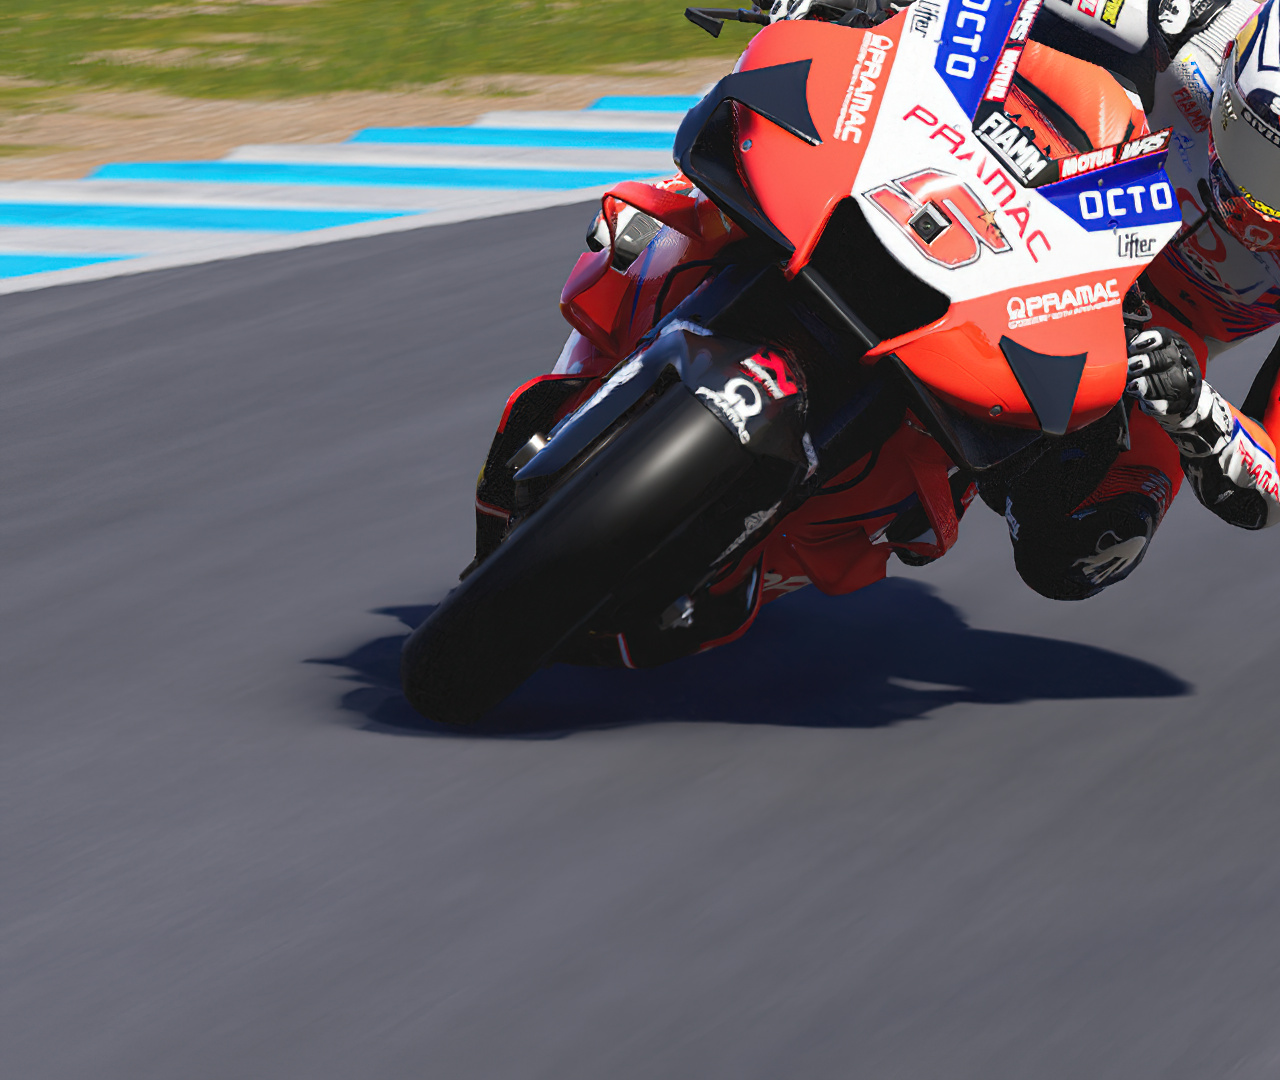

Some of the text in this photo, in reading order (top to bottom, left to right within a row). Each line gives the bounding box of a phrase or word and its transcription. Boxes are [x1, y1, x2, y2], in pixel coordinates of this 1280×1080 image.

[841, 44, 888, 145] PRAMAC
[978, 110, 1049, 181] FIAMM
[1061, 147, 1116, 178] MOTUL
[902, 104, 1052, 264] PRAMAC
[1078, 182, 1173, 220] OCTO
[861, 167, 1014, 269] 5
[1118, 232, 1157, 258] Lifter
[1025, 278, 1120, 318] PRAMAC
